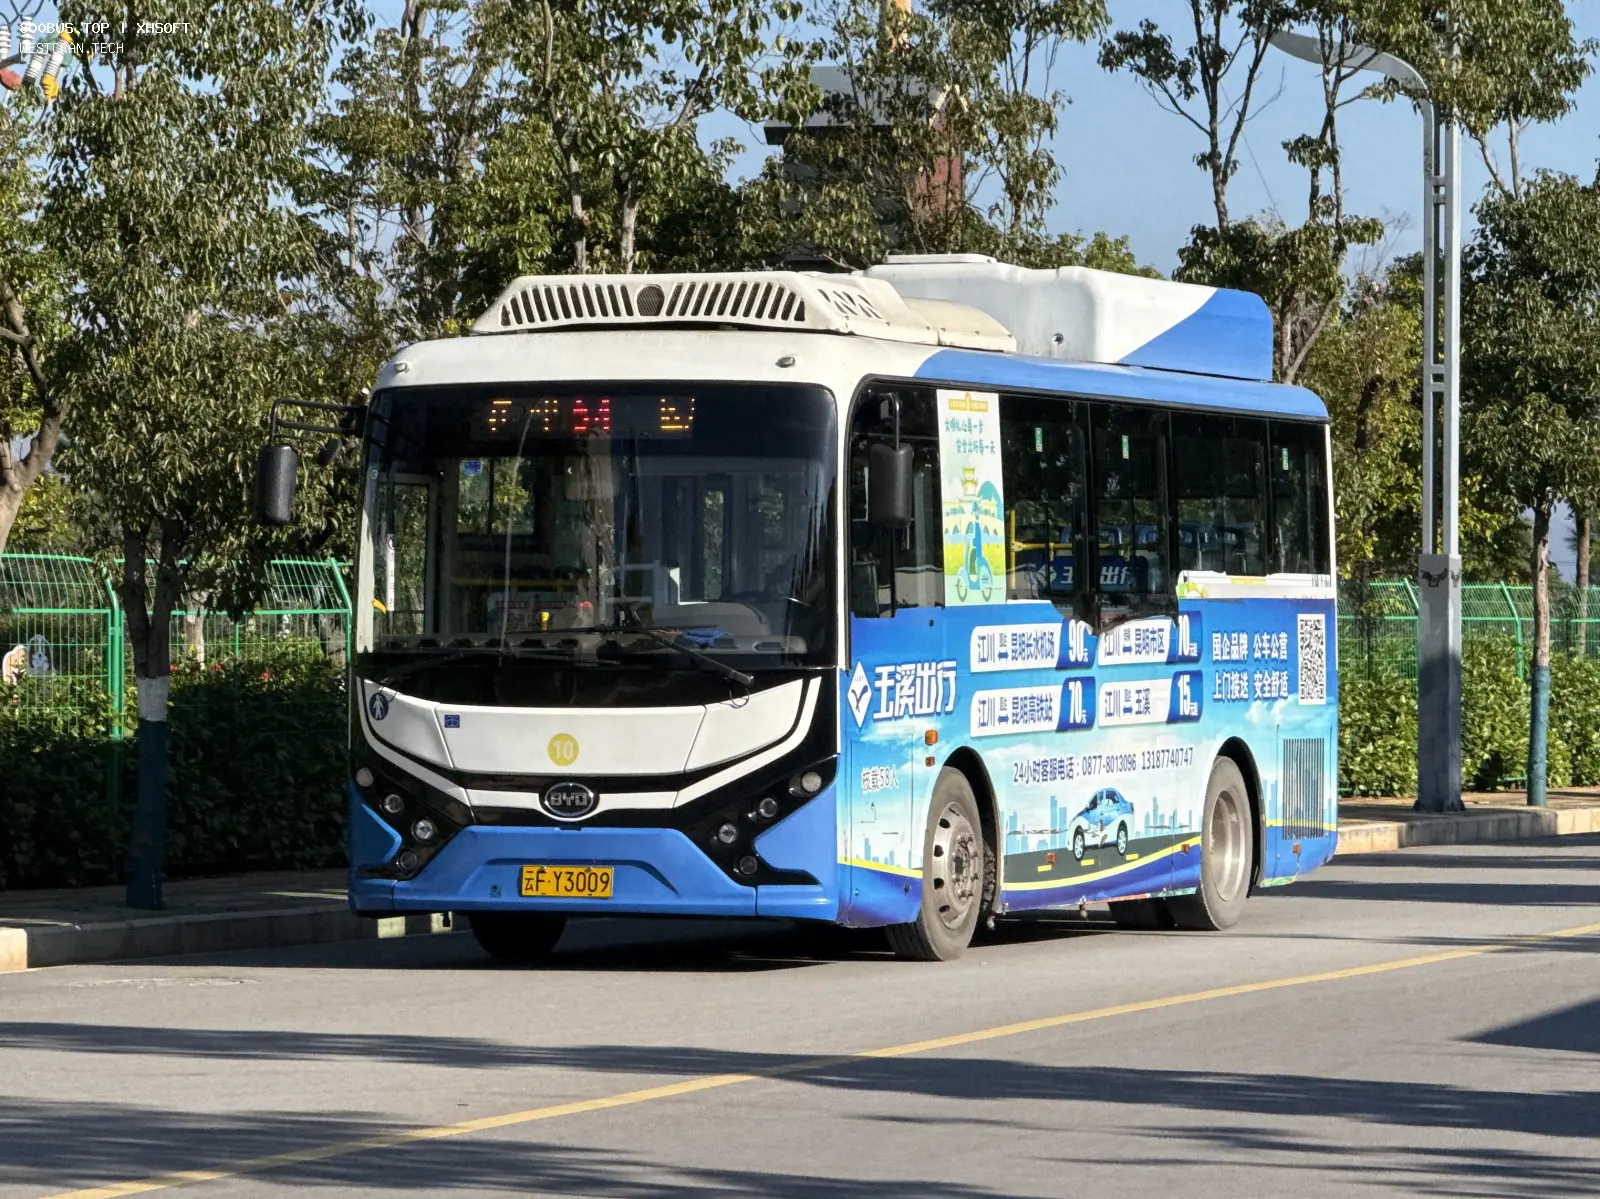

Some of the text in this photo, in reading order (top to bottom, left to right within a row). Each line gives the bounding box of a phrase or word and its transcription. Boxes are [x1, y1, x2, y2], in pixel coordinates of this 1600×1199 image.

[977, 632, 996, 664] 江川
[1011, 630, 1055, 662] 昆明长水机场
[1104, 627, 1121, 658] 江川
[1135, 627, 1165, 656] 昆明市区
[1212, 631, 1288, 661] 国企品牌 公车公营
[873, 660, 957, 719] 玉溪出行
[1213, 670, 1289, 700] 上门接送 安全舒适
[977, 697, 996, 728] 江川
[1011, 692, 1053, 725] 昆明高铁站
[1104, 689, 1121, 718] 江川
[1135, 687, 1151, 716] 玉溪
[552, 740, 574, 760] 10
[1141, 747, 1194, 770] 13187740747
[862, 766, 898, 792] 核载58人
[549, 793, 588, 807] BYD
